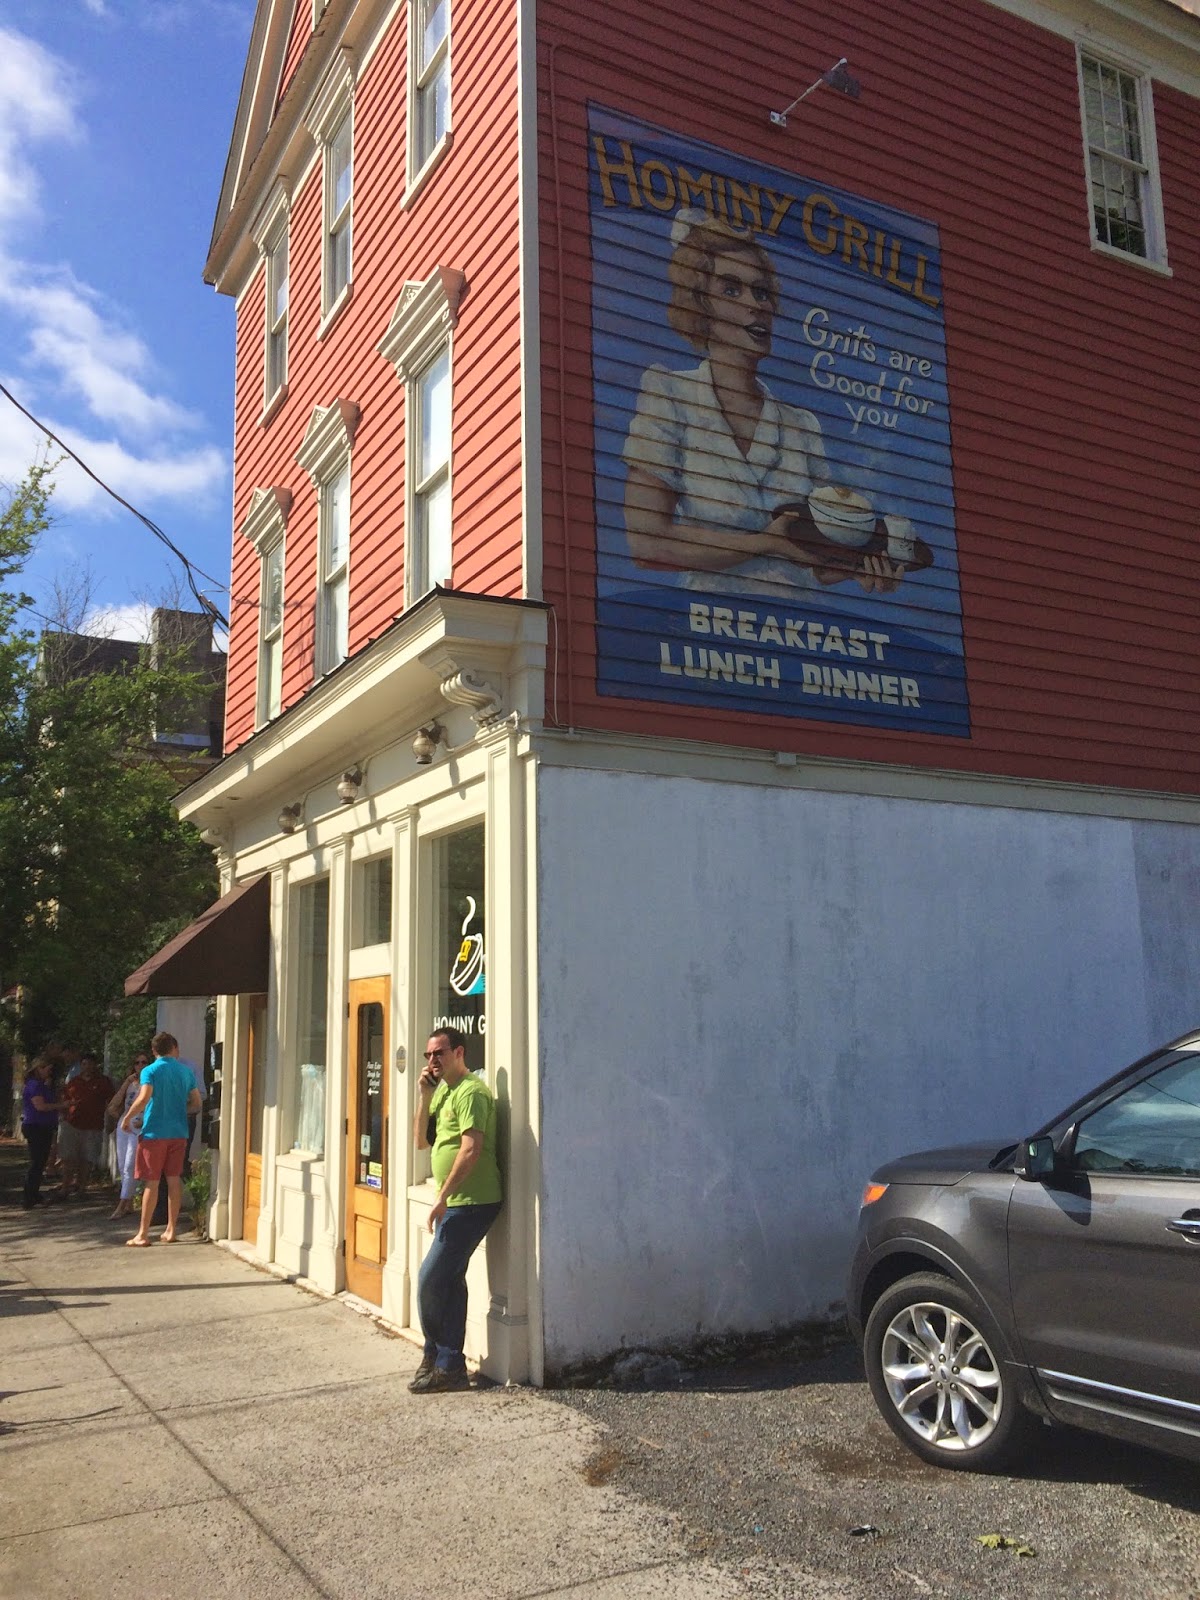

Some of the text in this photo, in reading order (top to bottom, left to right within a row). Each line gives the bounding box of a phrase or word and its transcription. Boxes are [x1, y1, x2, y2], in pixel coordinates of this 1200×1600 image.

[592, 136, 941, 308] HOMINY GRILL
[803, 308, 933, 377] Grits are
[810, 351, 935, 414] Good for
[845, 402, 899, 434] you
[689, 603, 890, 661] BREAKFAST
[660, 642, 921, 708] LUNCH DINNER
[433, 1015, 475, 1034] HOMINY
